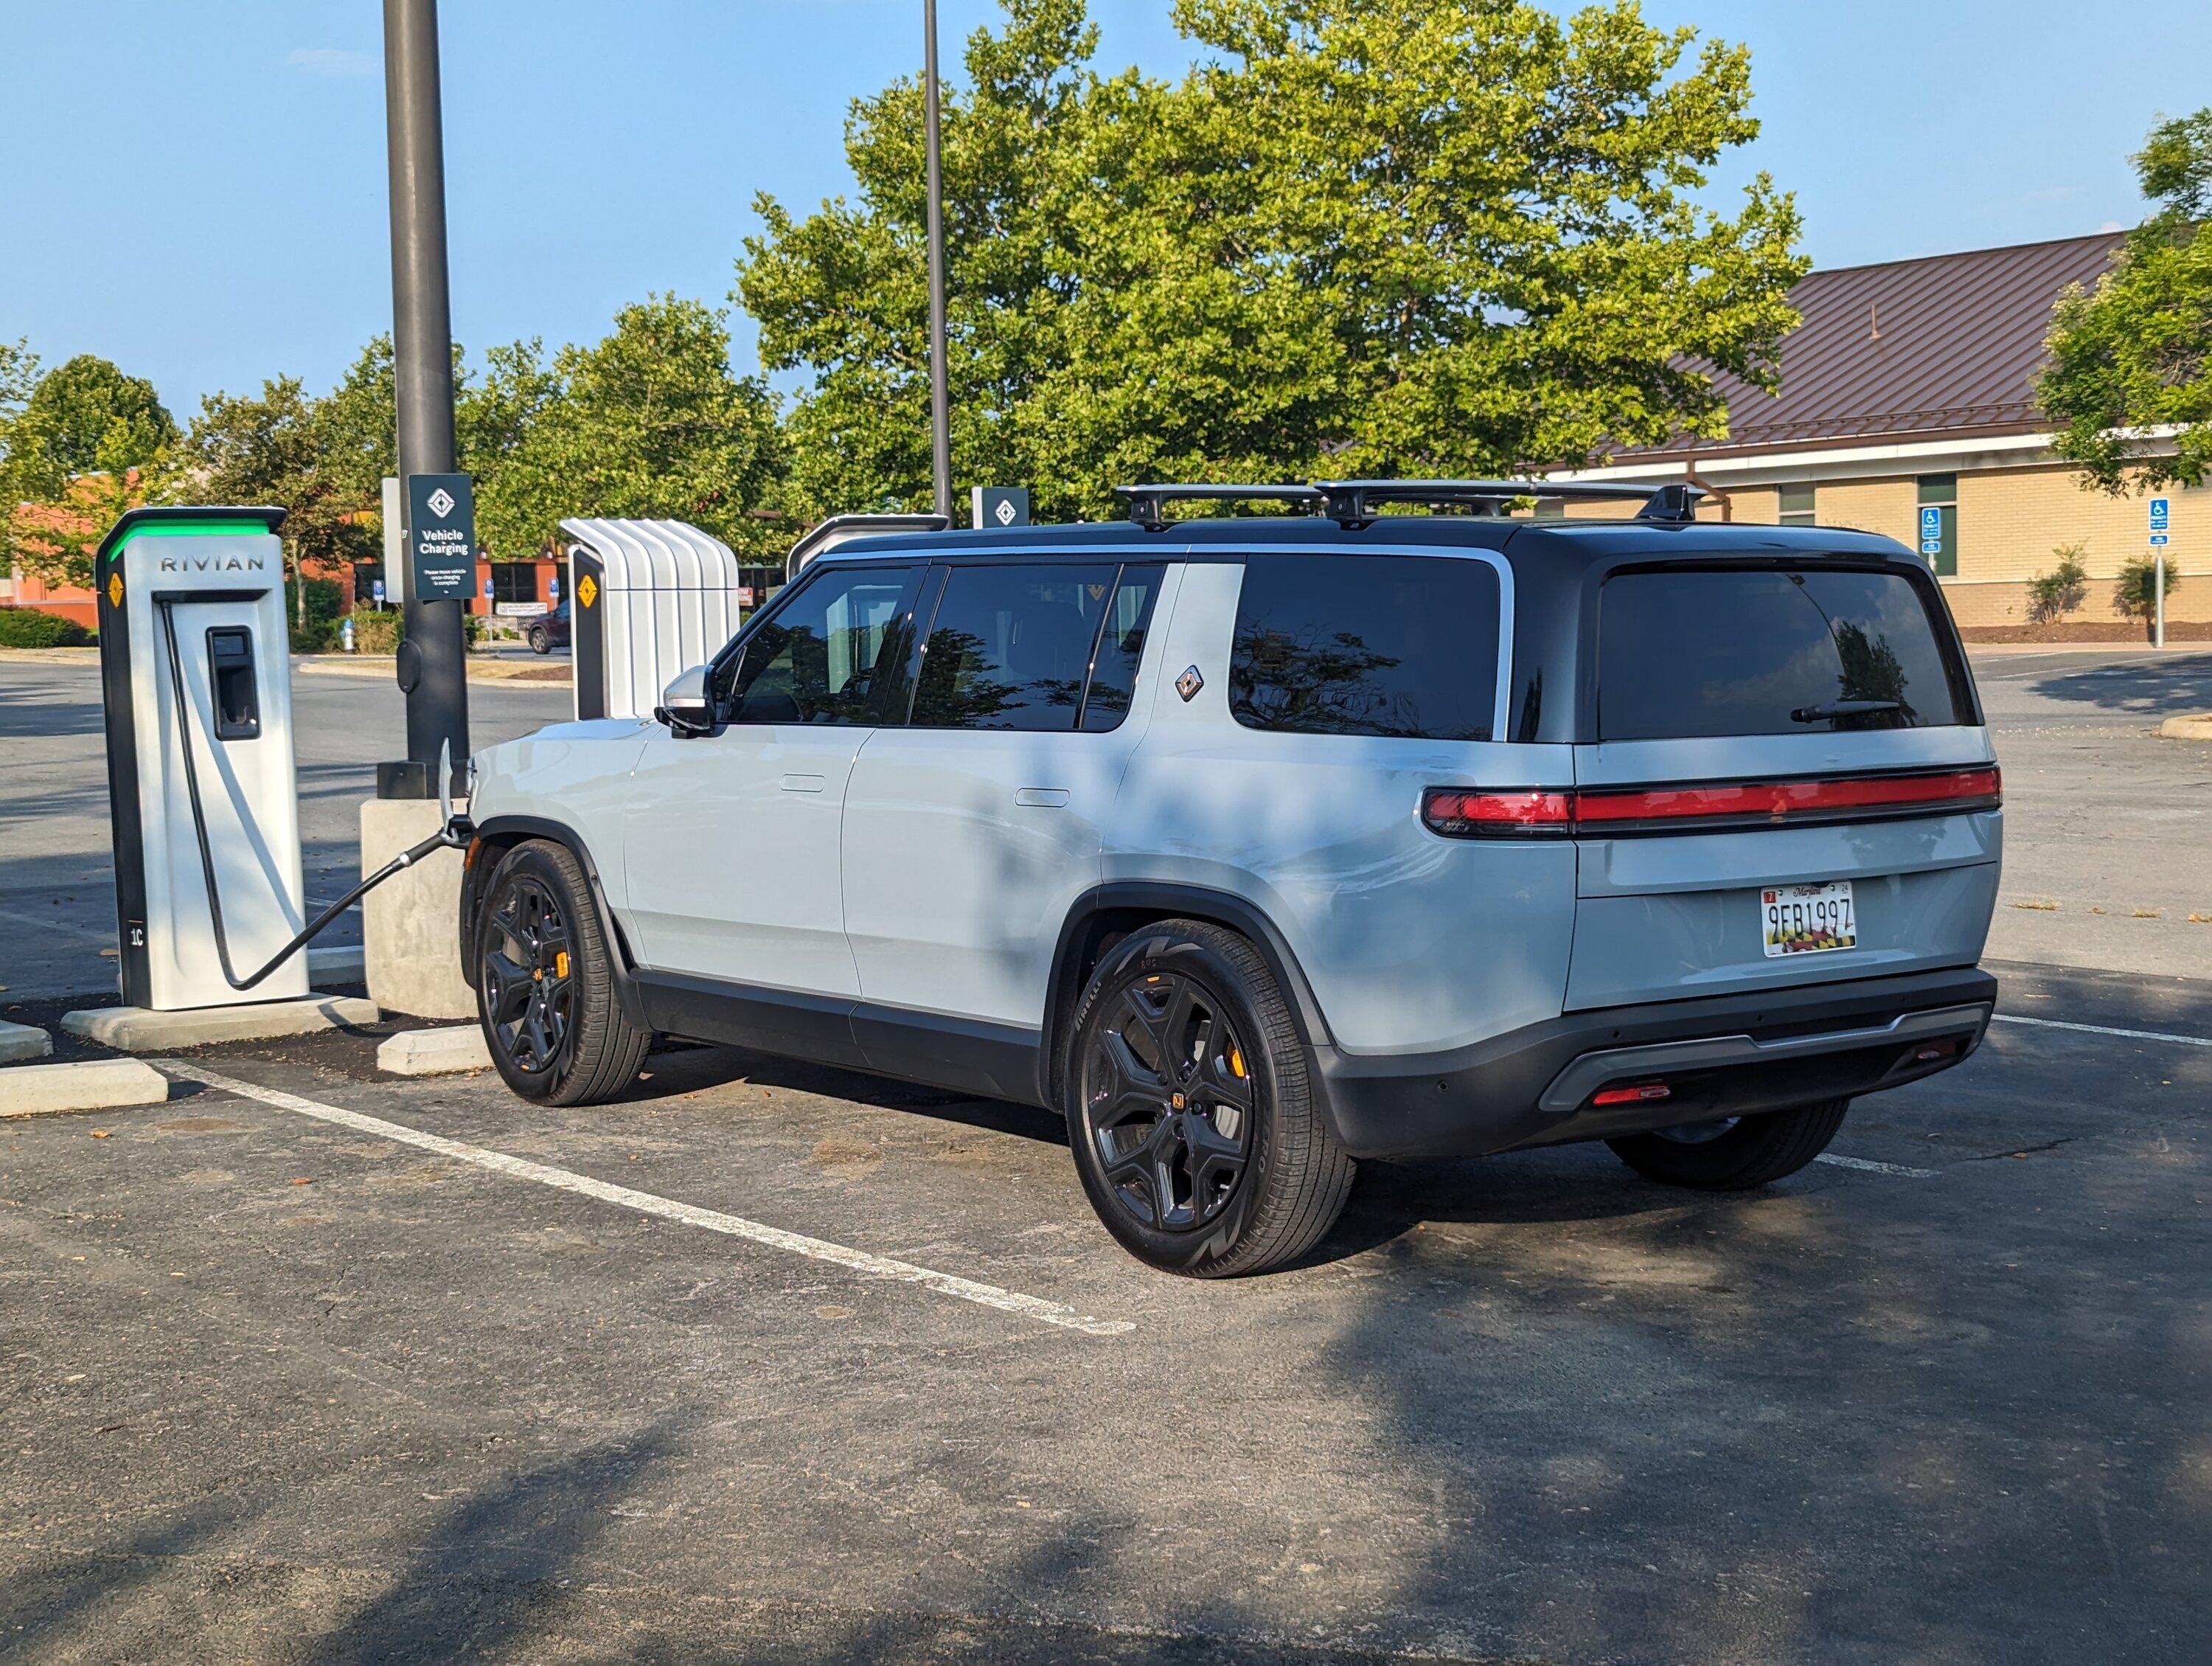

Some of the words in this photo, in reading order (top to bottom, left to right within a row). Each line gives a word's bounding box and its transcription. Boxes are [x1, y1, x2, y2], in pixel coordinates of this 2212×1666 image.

[421, 529, 464, 541] Vehicle
[419, 543, 468, 556] Charging
[161, 554, 264, 572] RIVIAN
[1793, 886, 1820, 898] Maryland
[1769, 898, 1849, 944] 9FB1997
[131, 928, 143, 946] 1C
